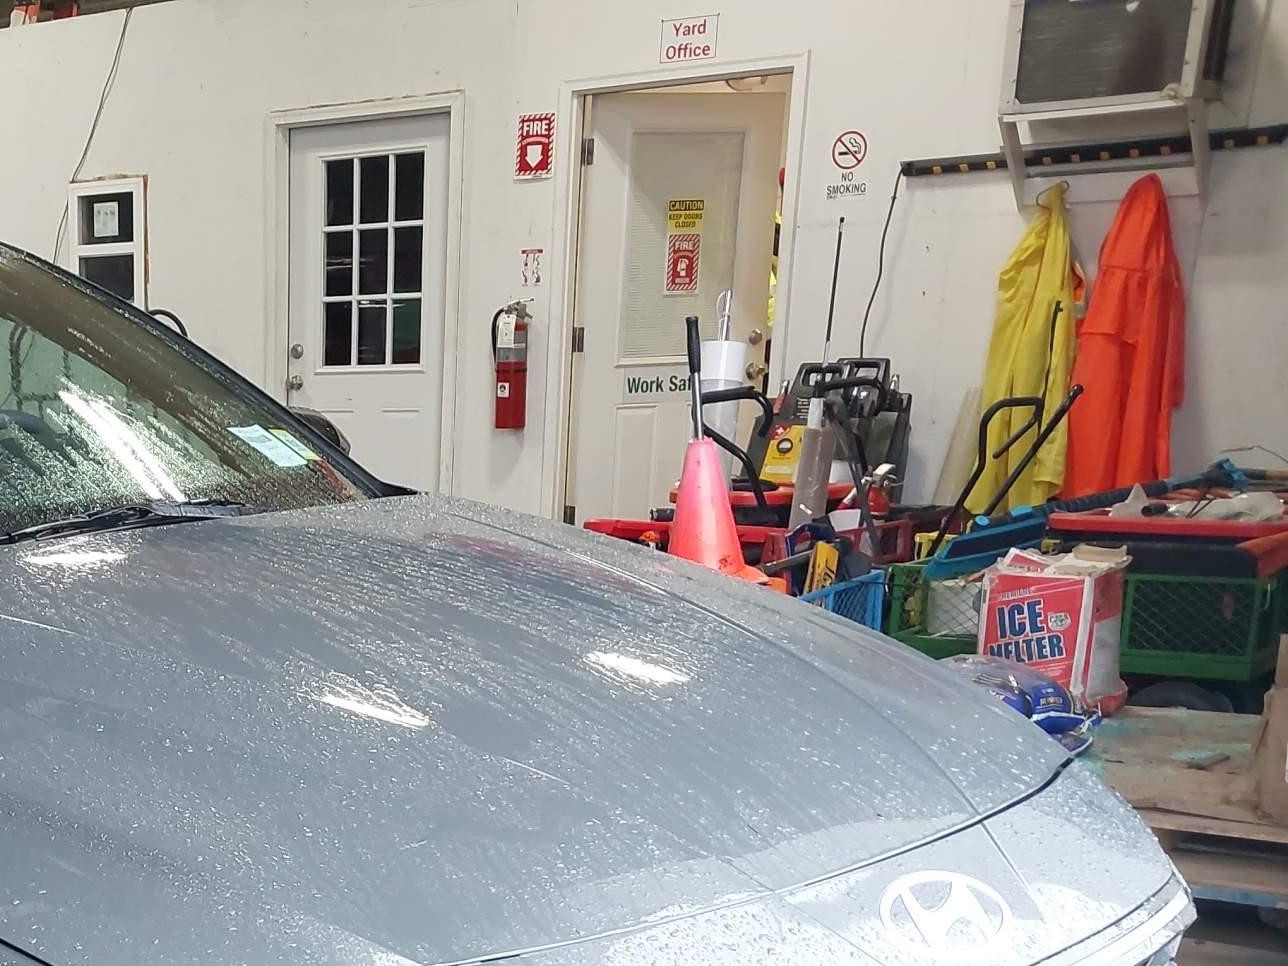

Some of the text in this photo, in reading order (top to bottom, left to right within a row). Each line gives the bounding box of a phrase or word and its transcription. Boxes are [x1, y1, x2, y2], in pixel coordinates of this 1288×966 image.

[673, 19, 707, 37] Yard
[665, 43, 711, 60] Office
[522, 120, 550, 136] FIRE
[841, 171, 854, 182] NO
[826, 182, 867, 196] SMOKING
[670, 201, 704, 210] CAUTION
[674, 220, 696, 228] CLOSED
[674, 240, 696, 251] FIRE
[627, 376, 664, 394] Work
[997, 599, 1047, 640] ICE
